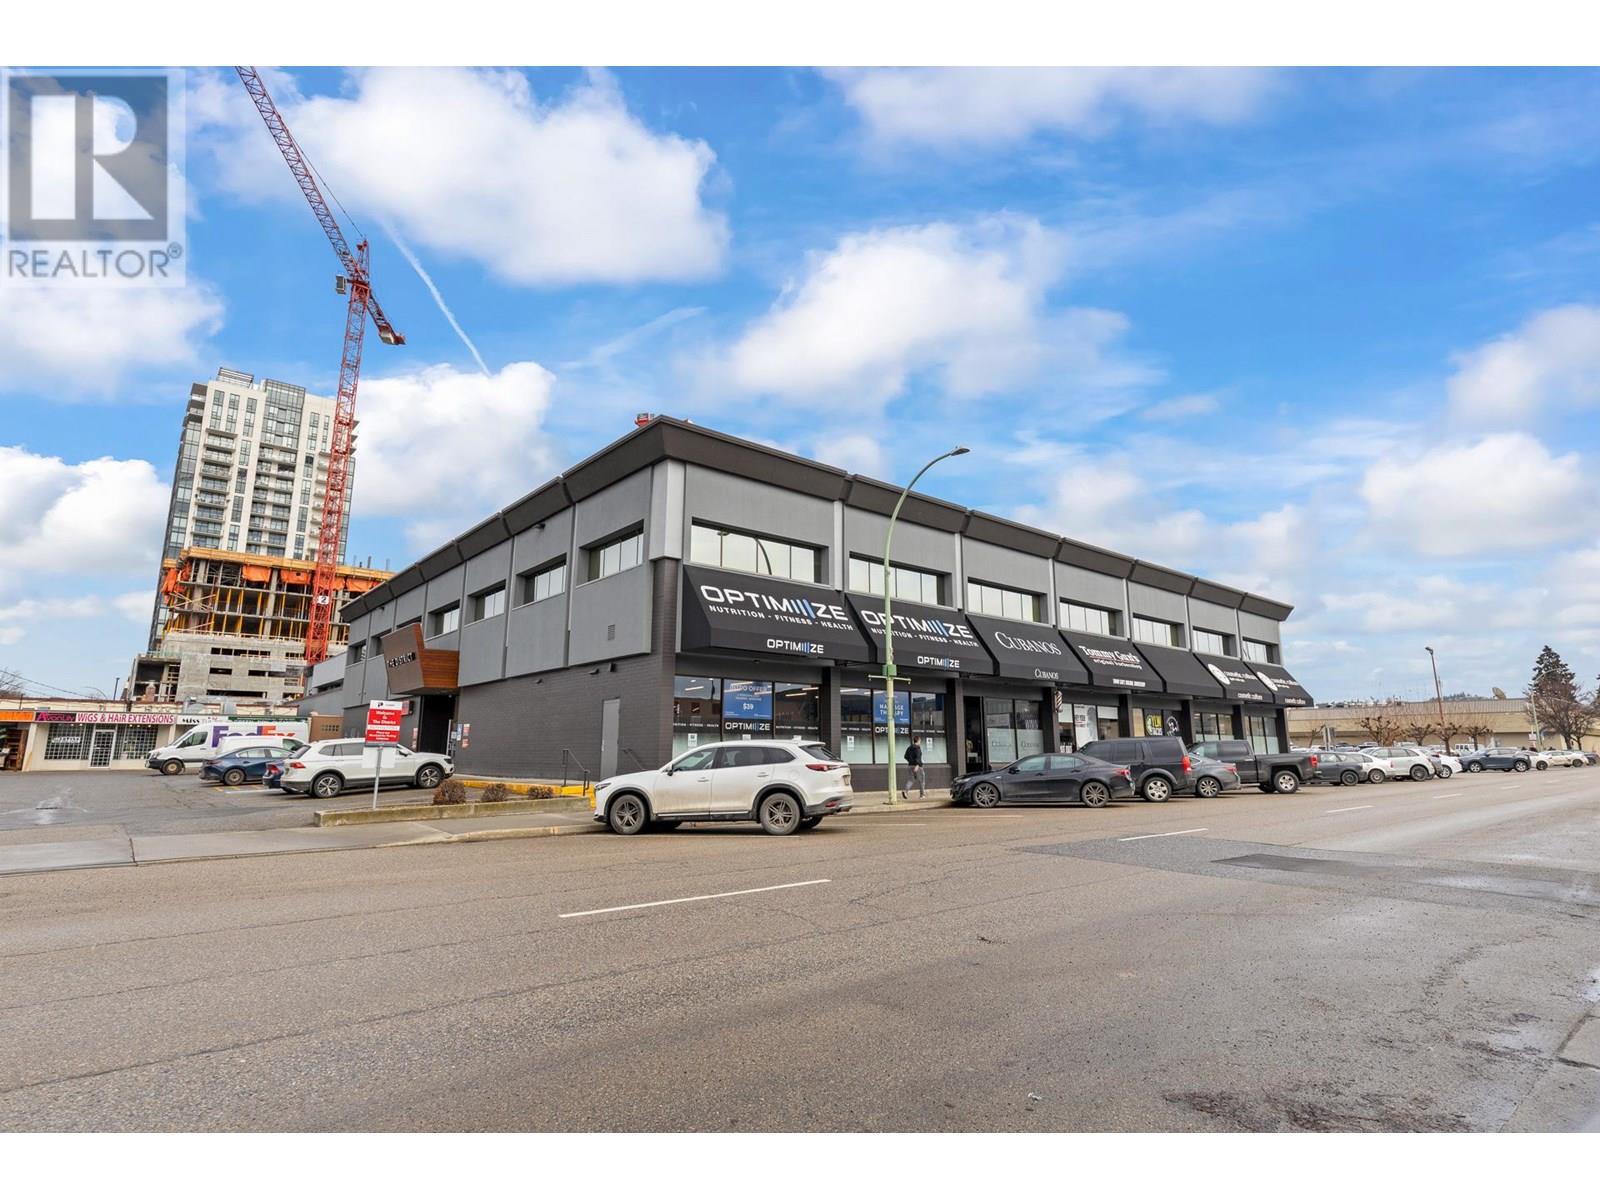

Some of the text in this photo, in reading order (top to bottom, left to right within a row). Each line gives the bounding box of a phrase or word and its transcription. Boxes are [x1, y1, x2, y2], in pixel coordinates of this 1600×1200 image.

[709, 604, 765, 619] NUTRITION
[774, 614, 812, 625] FITNESS
[821, 620, 854, 631] HEALTH
[870, 627, 913, 639] NUTITION
[919, 634, 948, 644] FITNESS
[953, 638, 979, 648] HEALTH
[994, 631, 1062, 656] CUBANOS
[1078, 645, 1115, 660] Tommy
[100, 714, 106, 722] &
